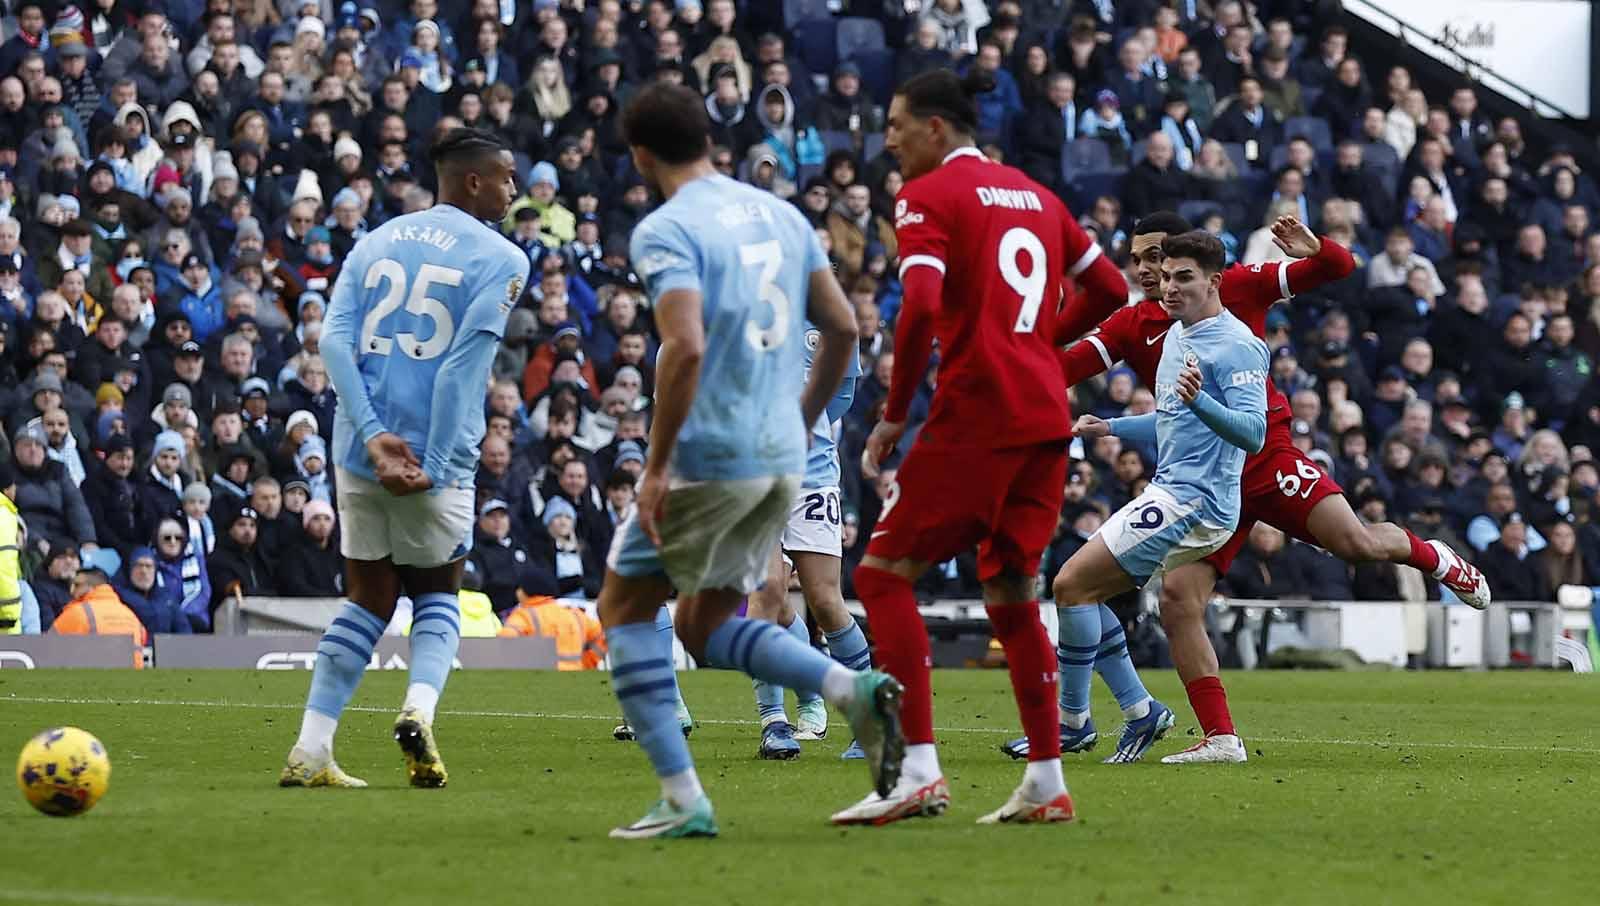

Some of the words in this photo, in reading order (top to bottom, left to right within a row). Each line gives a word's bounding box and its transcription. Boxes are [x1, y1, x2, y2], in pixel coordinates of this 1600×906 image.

[975, 186, 1043, 213] DARWIN
[391, 225, 457, 251] AKANJI
[739, 239, 790, 352] 3
[998, 227, 1047, 333] 9
[360, 258, 464, 360] 25
[1276, 460, 1321, 497] 66
[805, 492, 840, 525] 20
